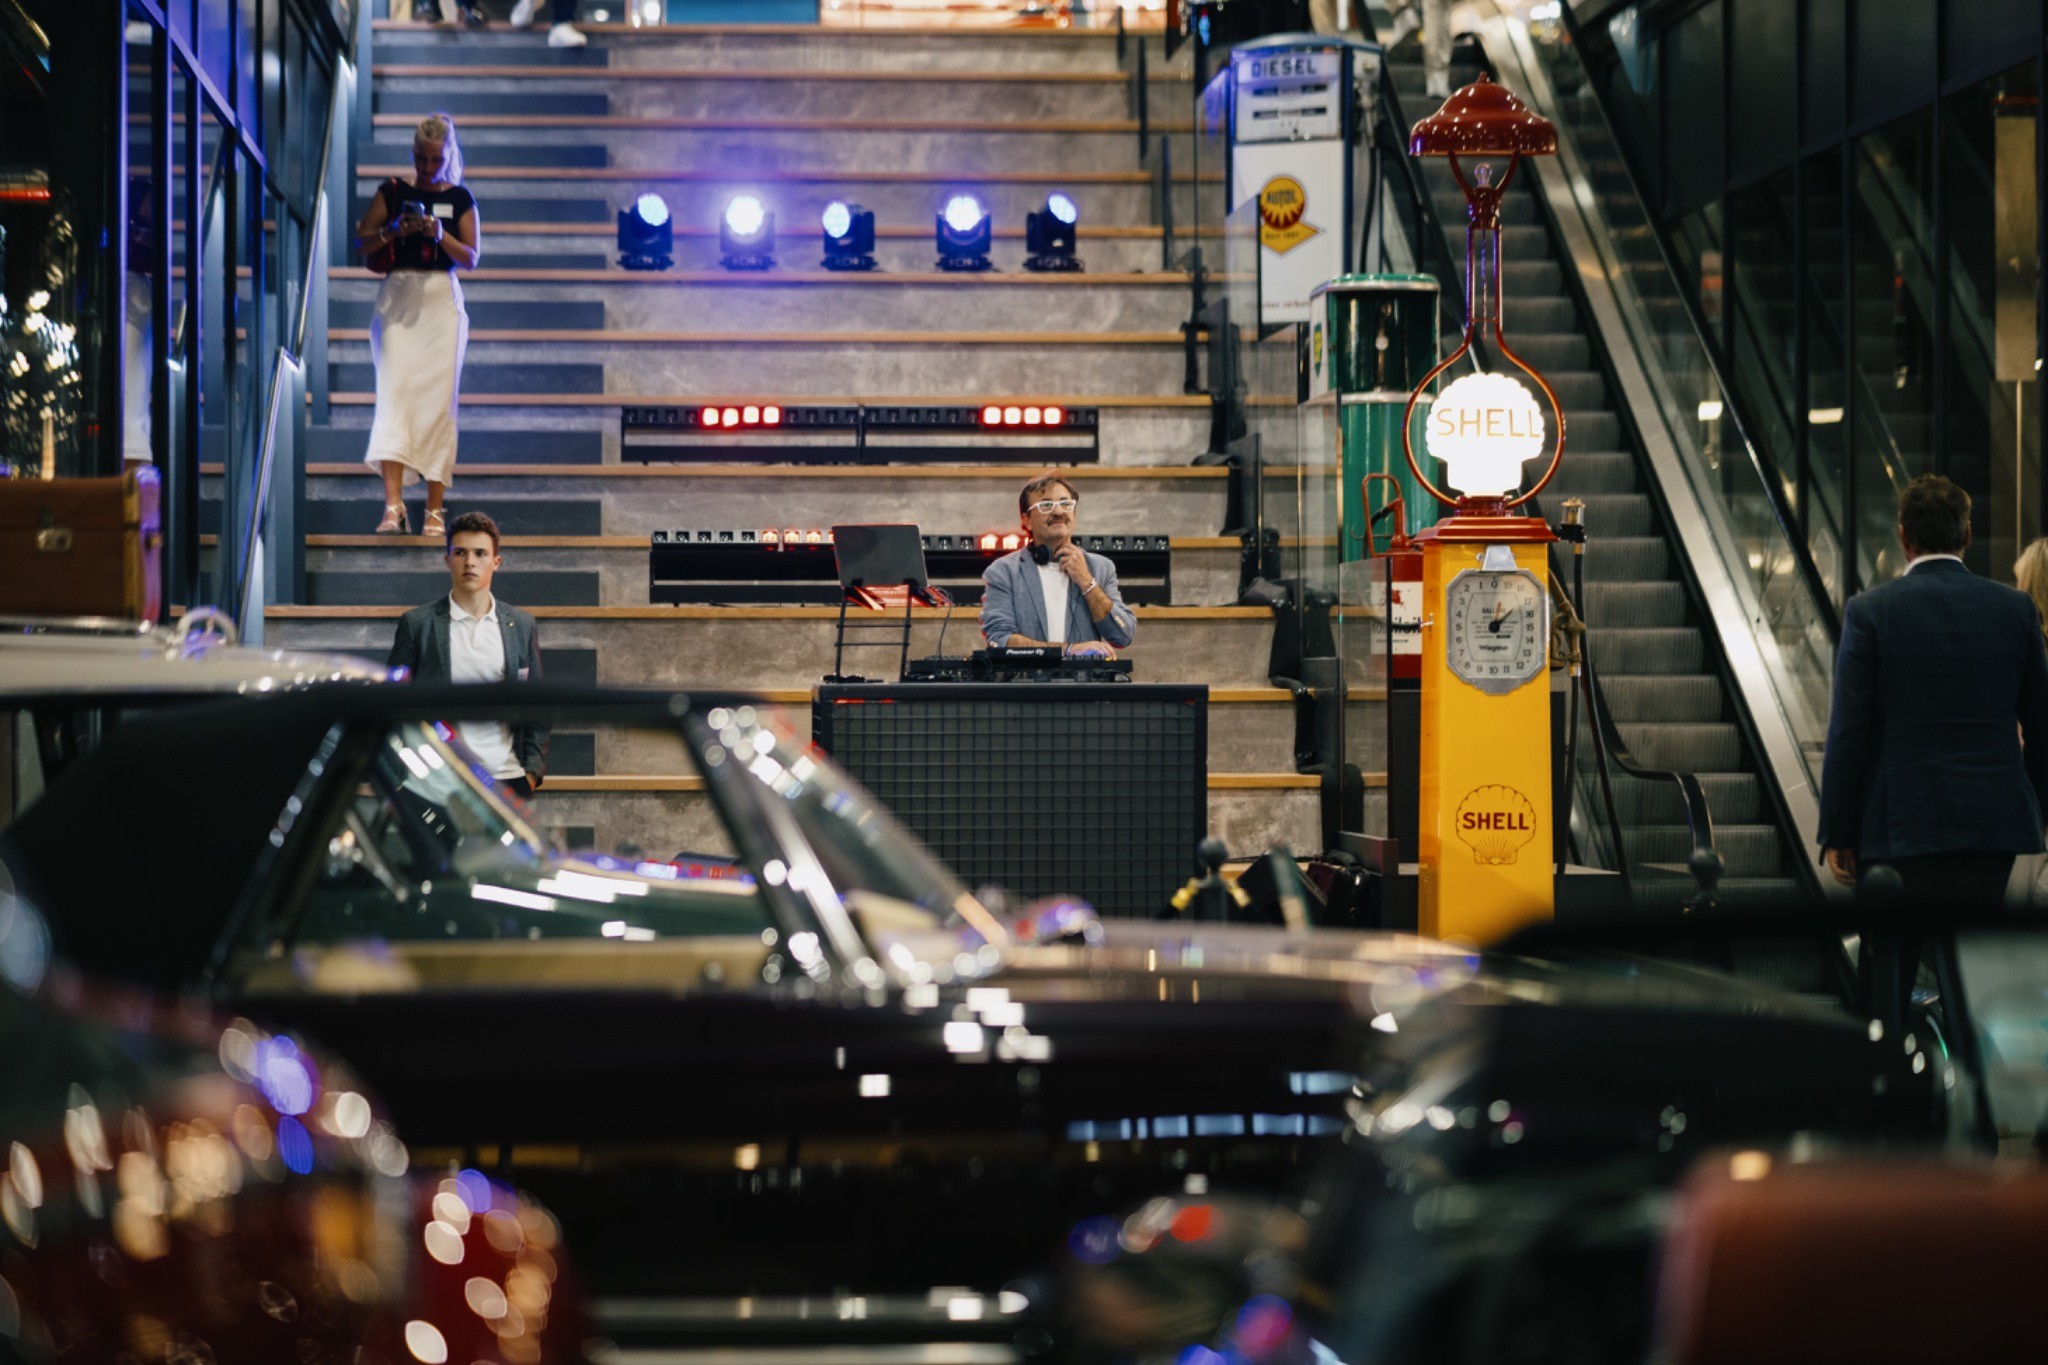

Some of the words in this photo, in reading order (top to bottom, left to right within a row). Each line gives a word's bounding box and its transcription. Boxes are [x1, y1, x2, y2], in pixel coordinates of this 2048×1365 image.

[1252, 60, 1317, 77] DIESEL
[1437, 408, 1540, 438] SHELL
[1464, 584, 1470, 592] 2
[1491, 580, 1498, 589] 0
[1459, 649, 1465, 657] 7
[1464, 661, 1471, 670] 8
[1476, 664, 1483, 673] 9
[1489, 666, 1498, 674] 10
[1503, 665, 1510, 673] 11
[1516, 661, 1525, 670] 12
[1462, 811, 1530, 830] SHELL
